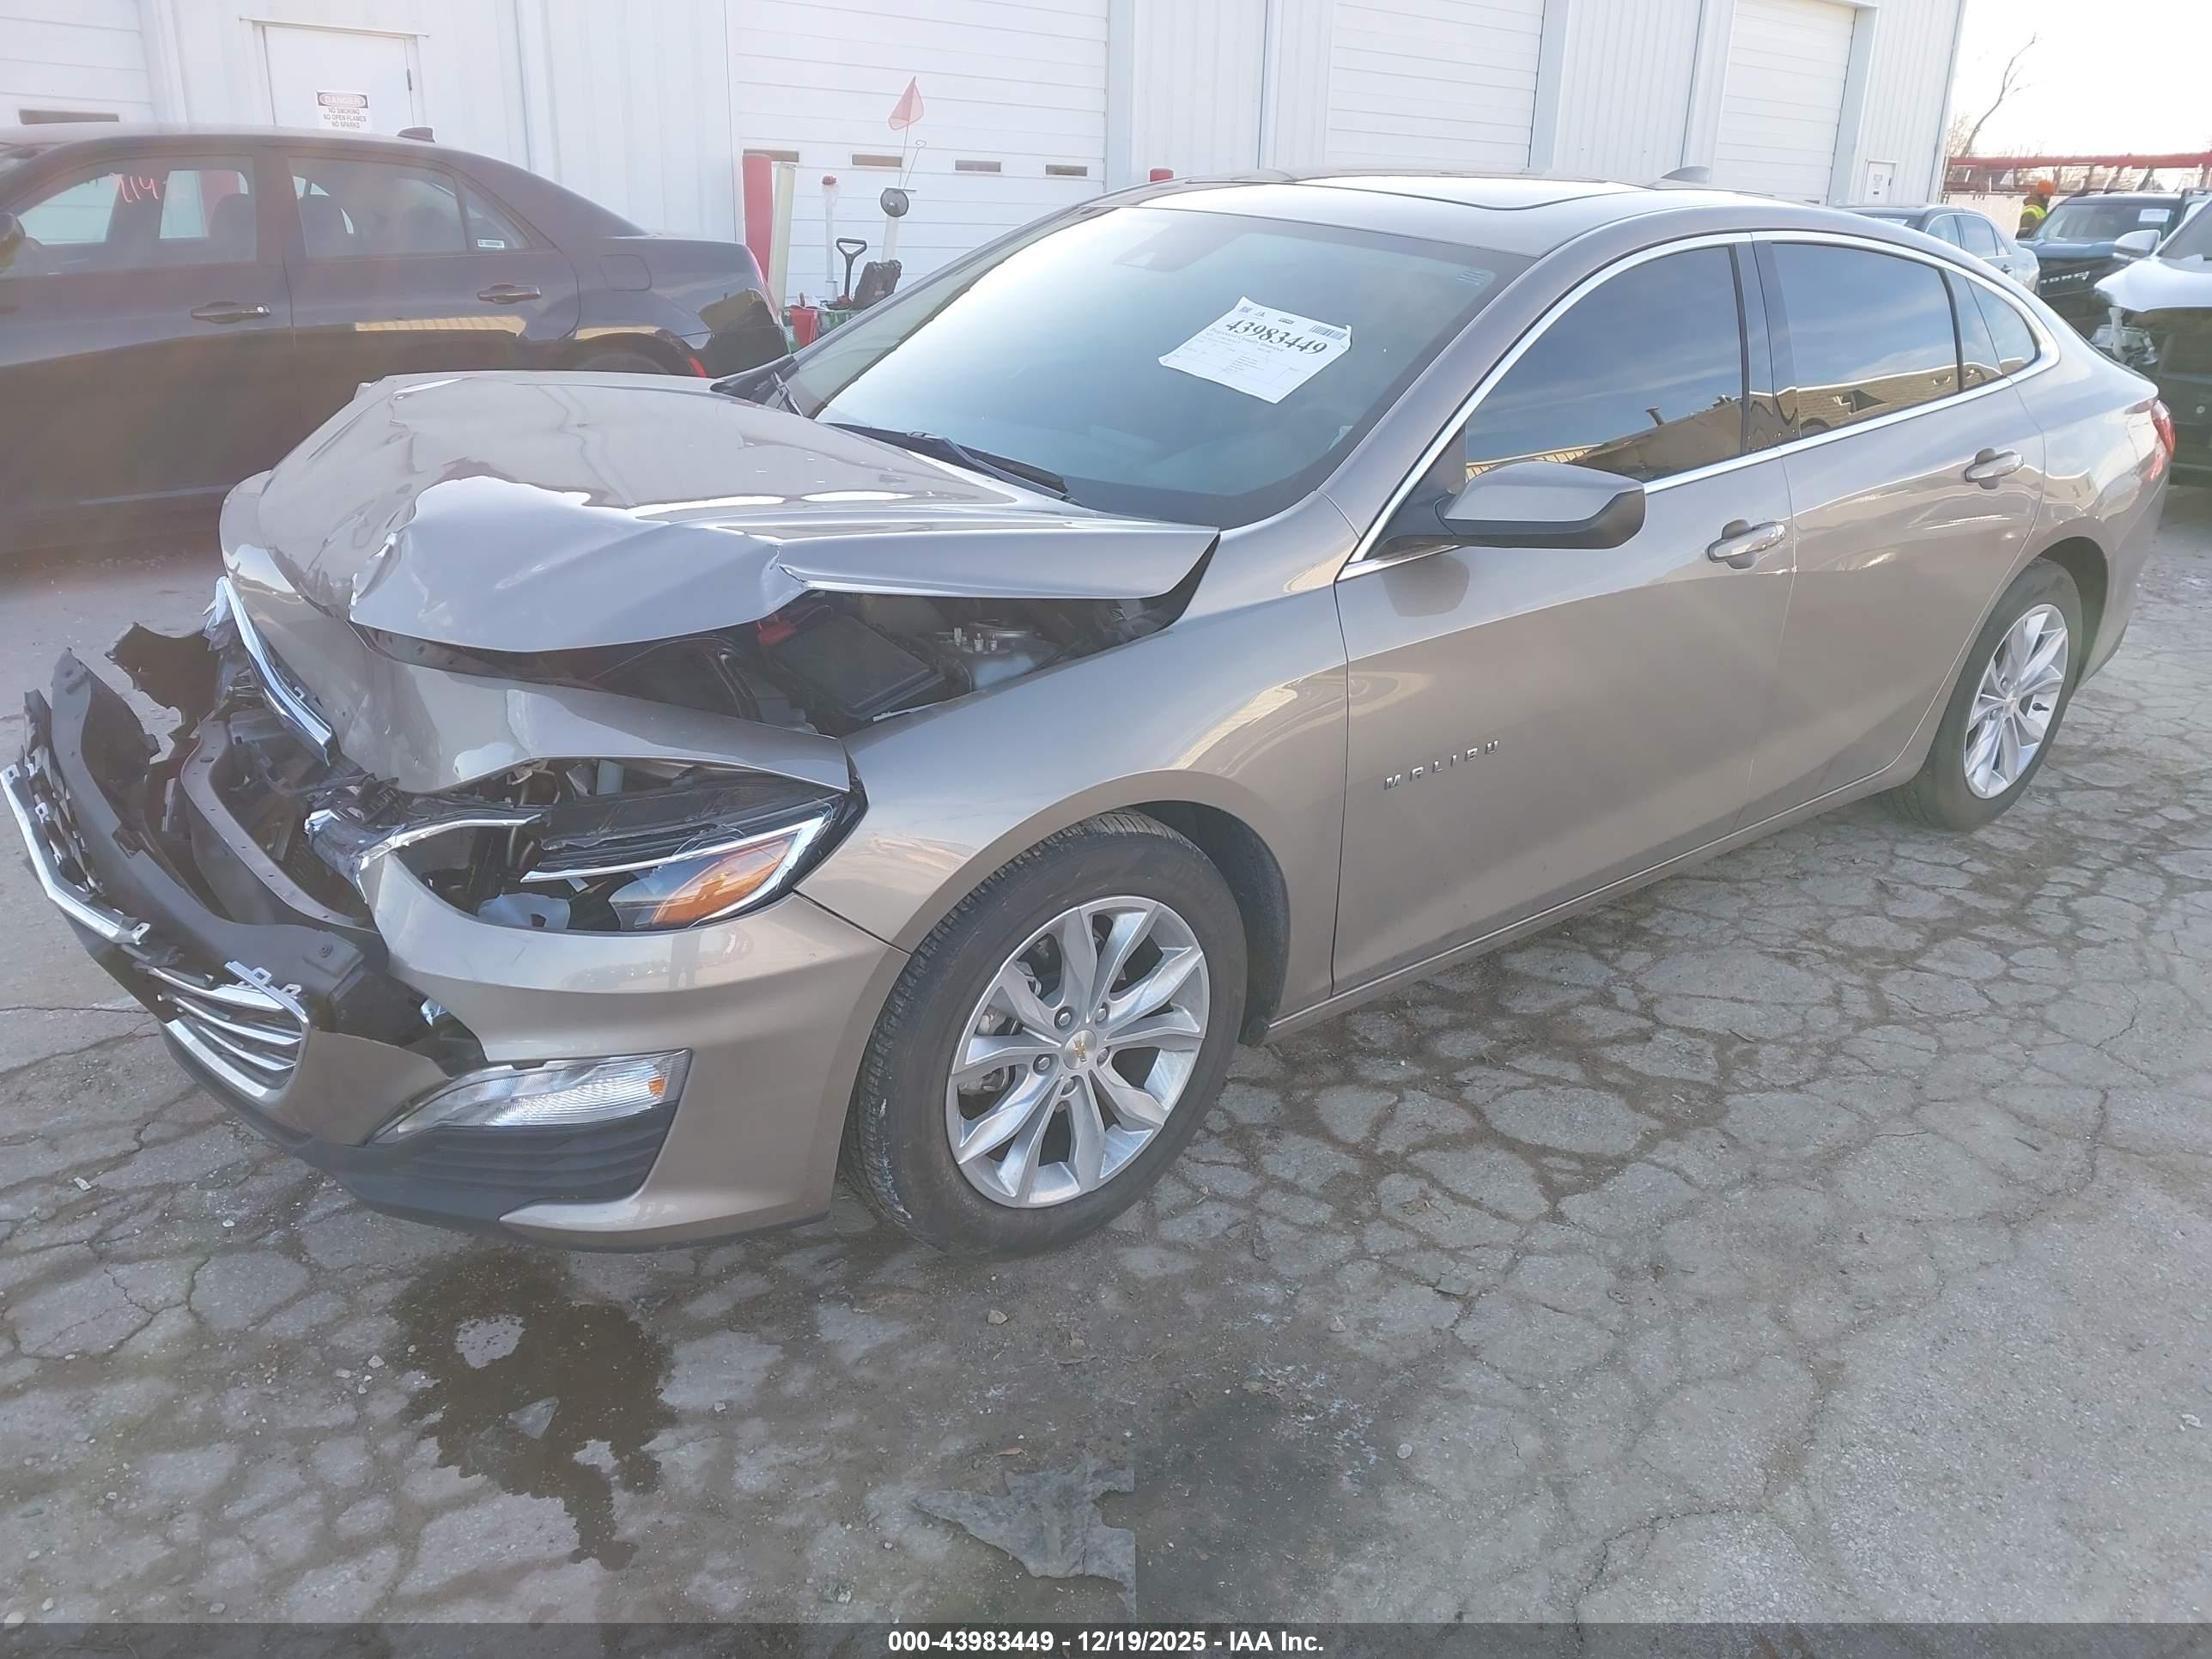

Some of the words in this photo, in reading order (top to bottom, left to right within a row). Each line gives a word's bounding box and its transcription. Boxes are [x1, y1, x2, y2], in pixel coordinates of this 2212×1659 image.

[324, 95, 362, 105] DANGER
[1225, 319, 1328, 355] 43983449
[1384, 739, 1498, 791] MALIBU
